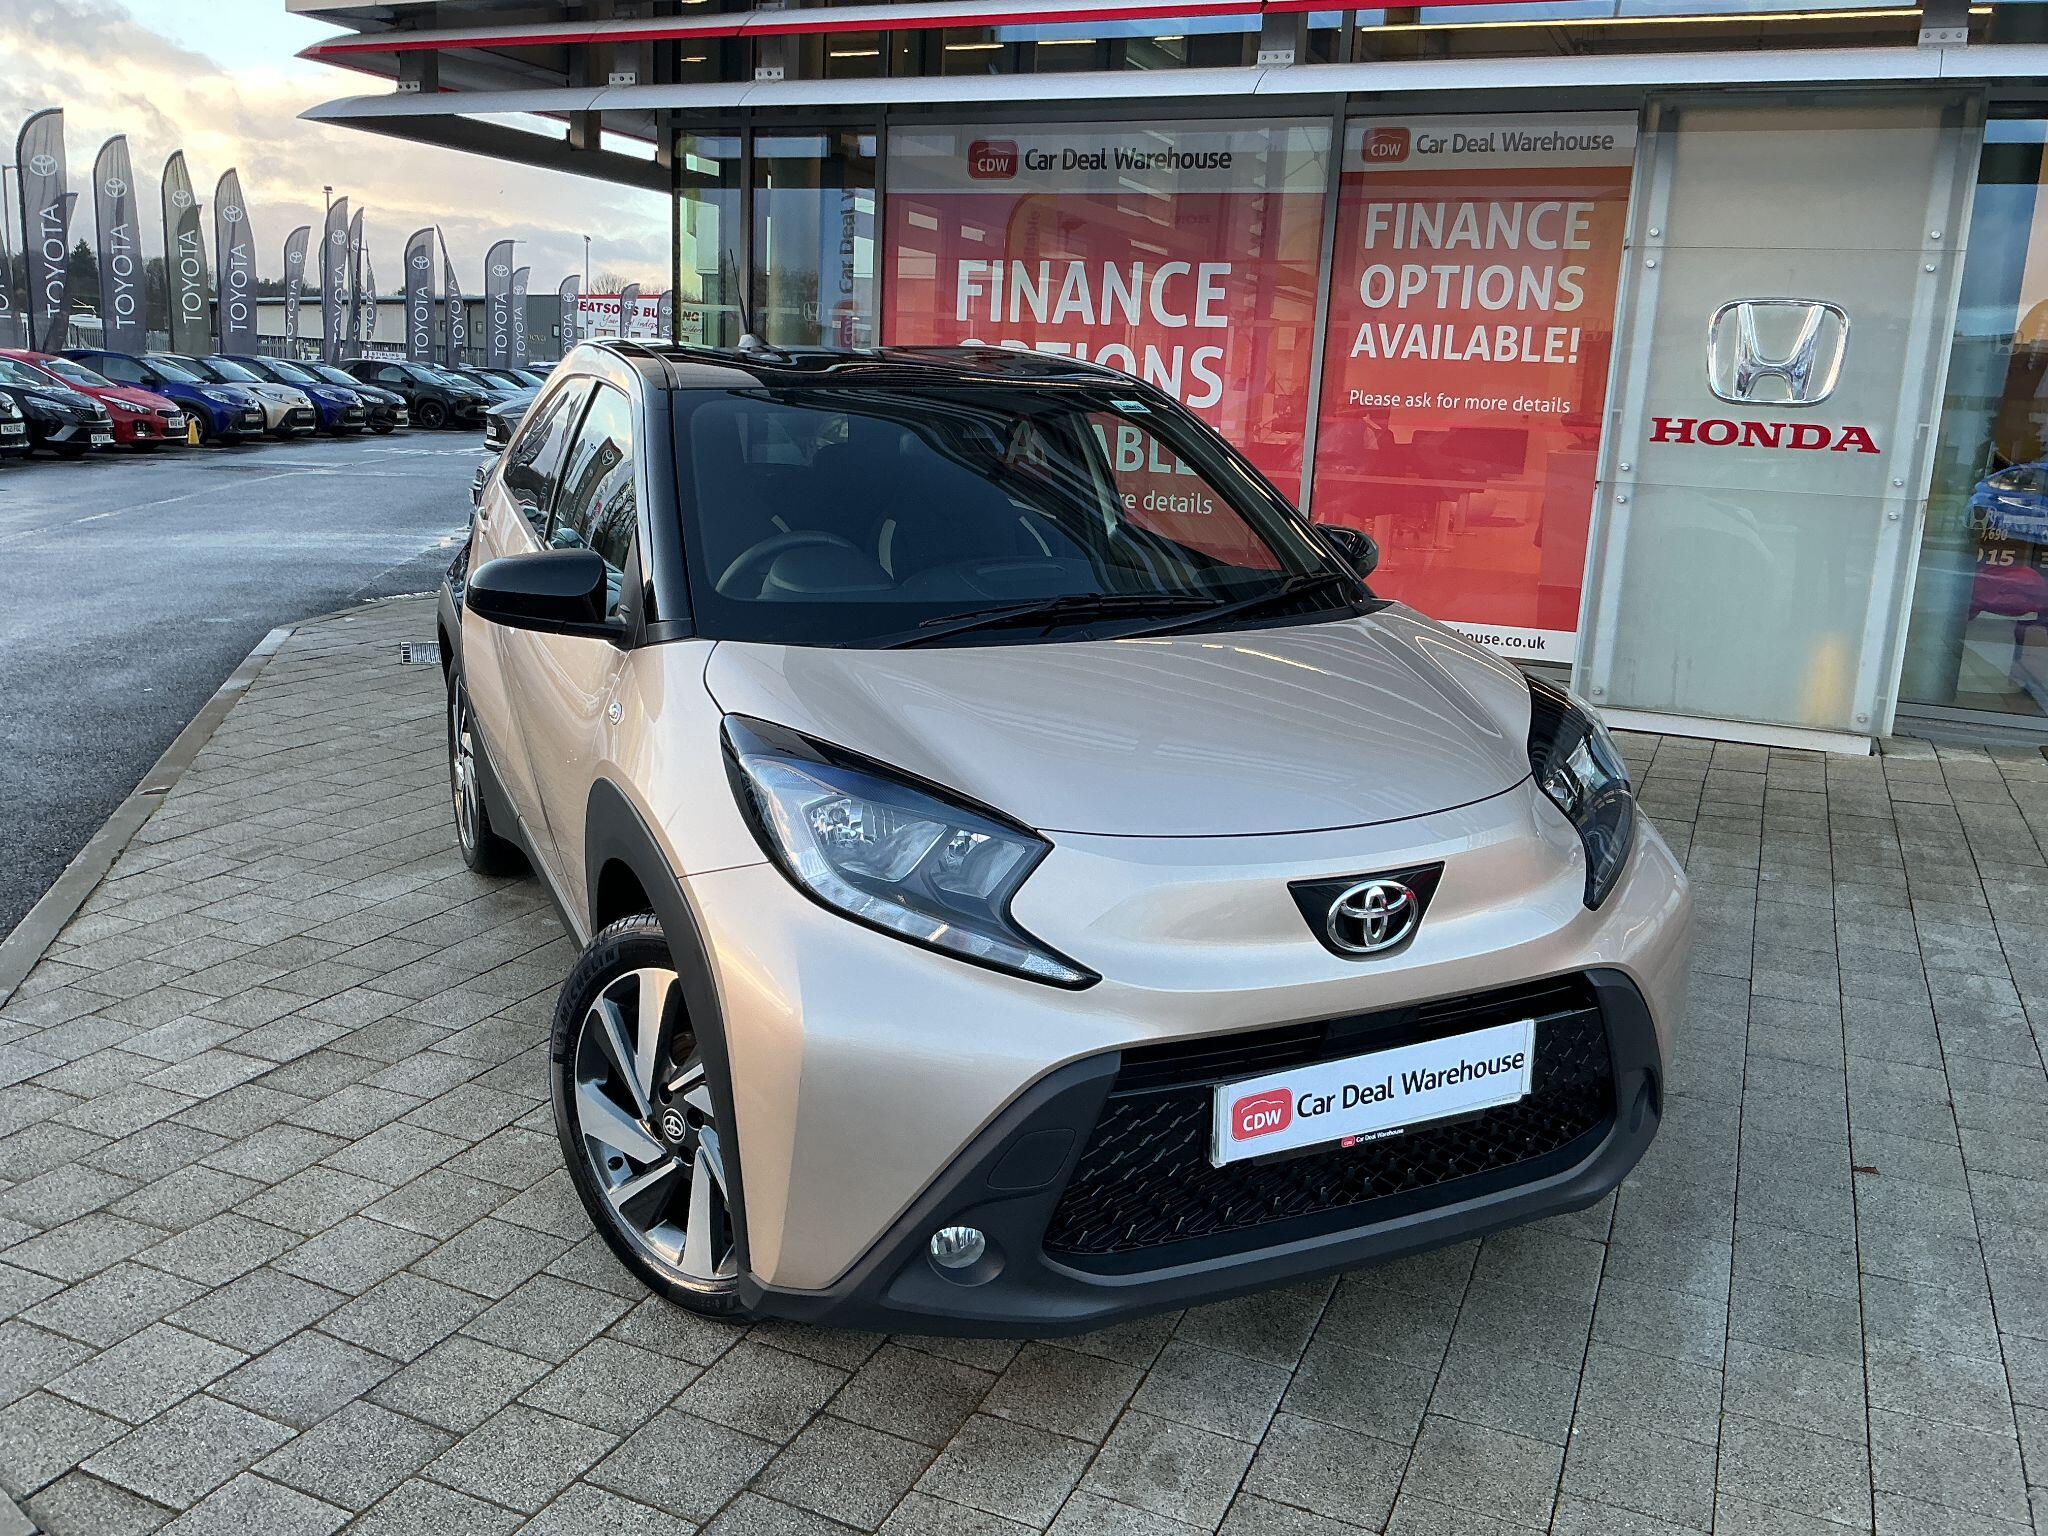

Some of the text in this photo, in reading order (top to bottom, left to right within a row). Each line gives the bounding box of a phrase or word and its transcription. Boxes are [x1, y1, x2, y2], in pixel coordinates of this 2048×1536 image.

[977, 157, 1009, 173] CDW
[1024, 146, 1233, 171] Car Deal Warehouse
[1370, 143, 1402, 158] CDW
[1415, 130, 1615, 154] Car Deal Warehouse
[1364, 201, 1596, 251] FINANCE
[39, 202, 67, 319] TOYOTA
[110, 222, 137, 331] TOYOTA
[179, 228, 203, 325] TOYOTA
[229, 242, 249, 333] TOYOTA
[286, 279, 299, 346] TOYOTA
[956, 258, 1232, 328] FINANCE
[1359, 263, 1587, 312] OPTIONS
[414, 285, 429, 357] TOYOTA
[447, 279, 465, 349] TOYOTA
[494, 292, 508, 357] TOYOTA
[513, 306, 526, 358] TOYOTA
[1350, 322, 1581, 364] AVAILABLE!
[1349, 389, 1571, 414] Please ask for more details
[1649, 416, 1881, 454] HONDA
[1142, 490, 1214, 515] details
[1297, 1051, 1525, 1118] Car Deal Warehouse
[1242, 1108, 1282, 1132] CDW
